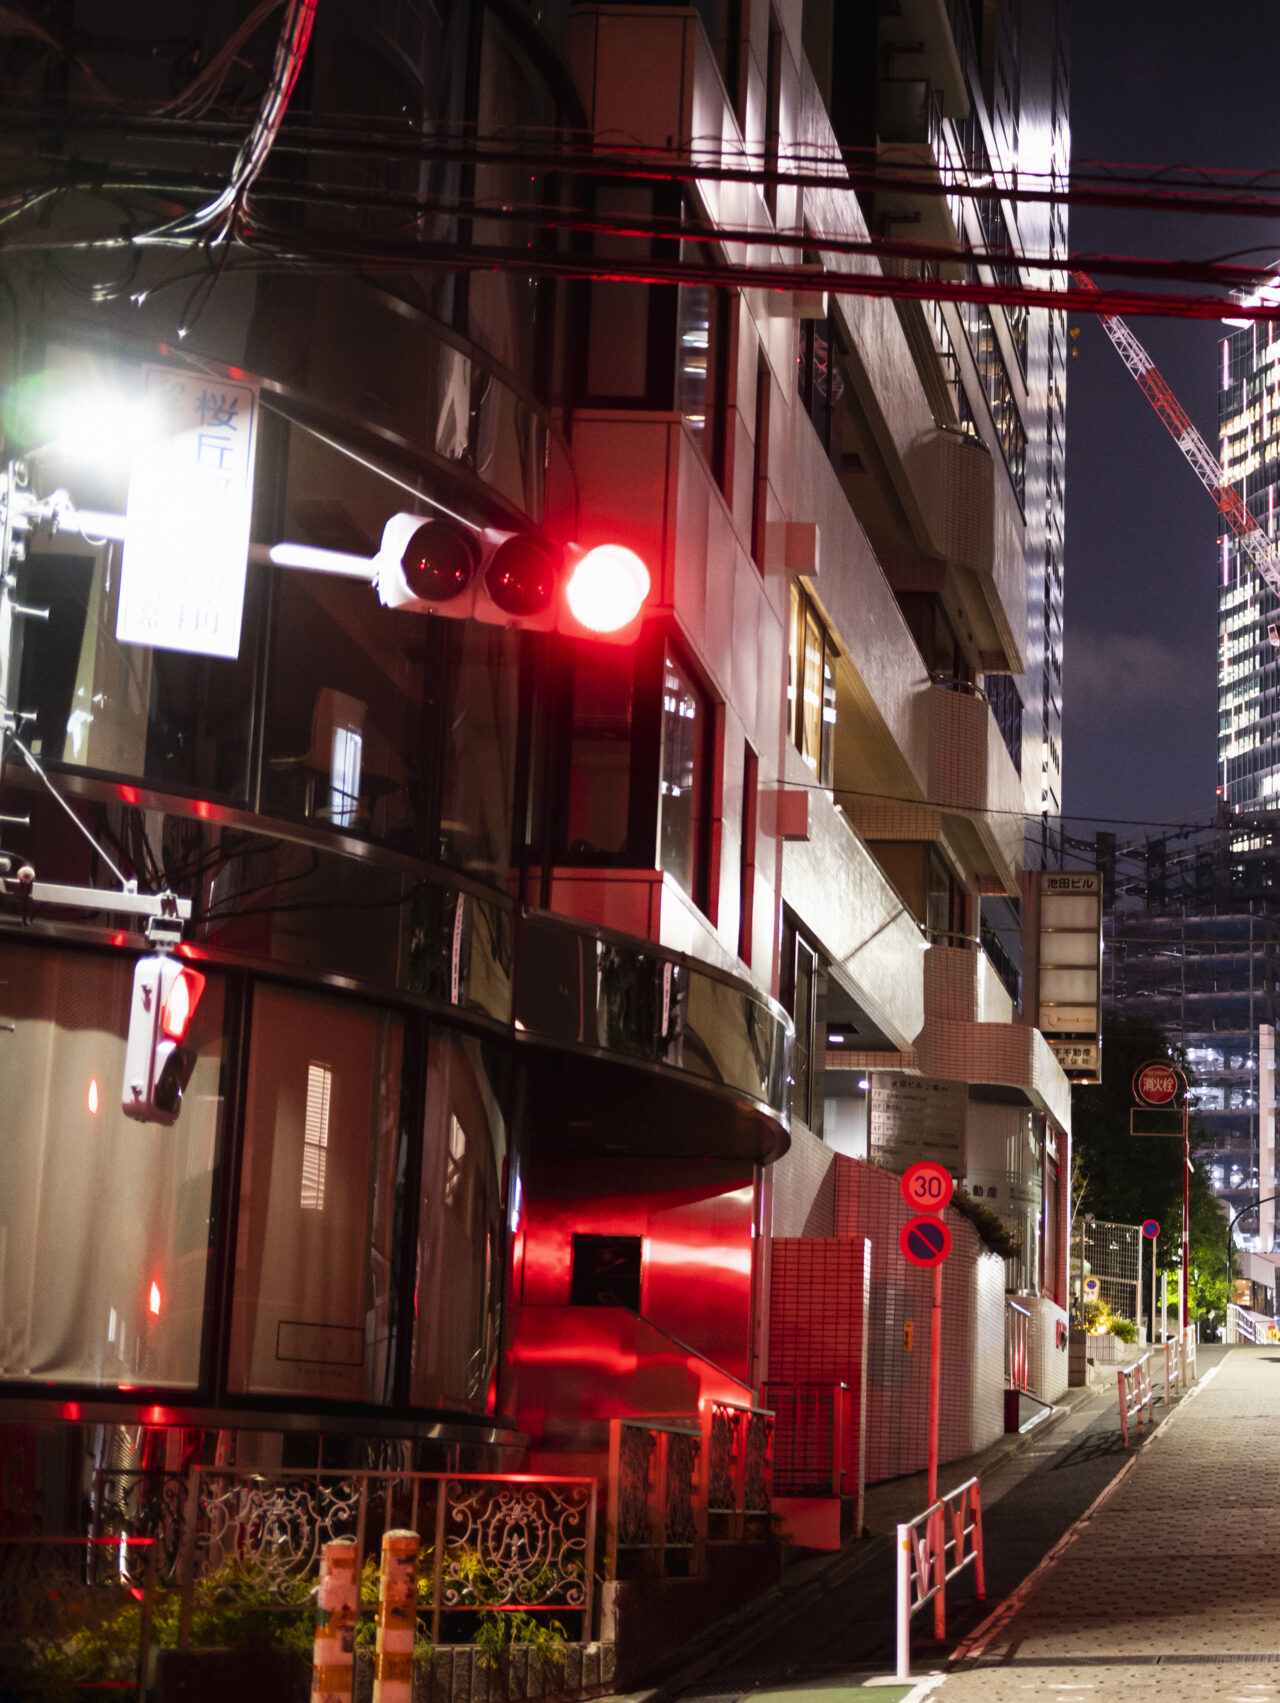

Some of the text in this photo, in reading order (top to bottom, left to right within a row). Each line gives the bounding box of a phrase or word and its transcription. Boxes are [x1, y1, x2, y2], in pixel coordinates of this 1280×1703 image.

[1047, 877, 1093, 889] 池田ビル
[1143, 1077, 1173, 1092] 消火栓
[914, 1176, 942, 1197] 30
